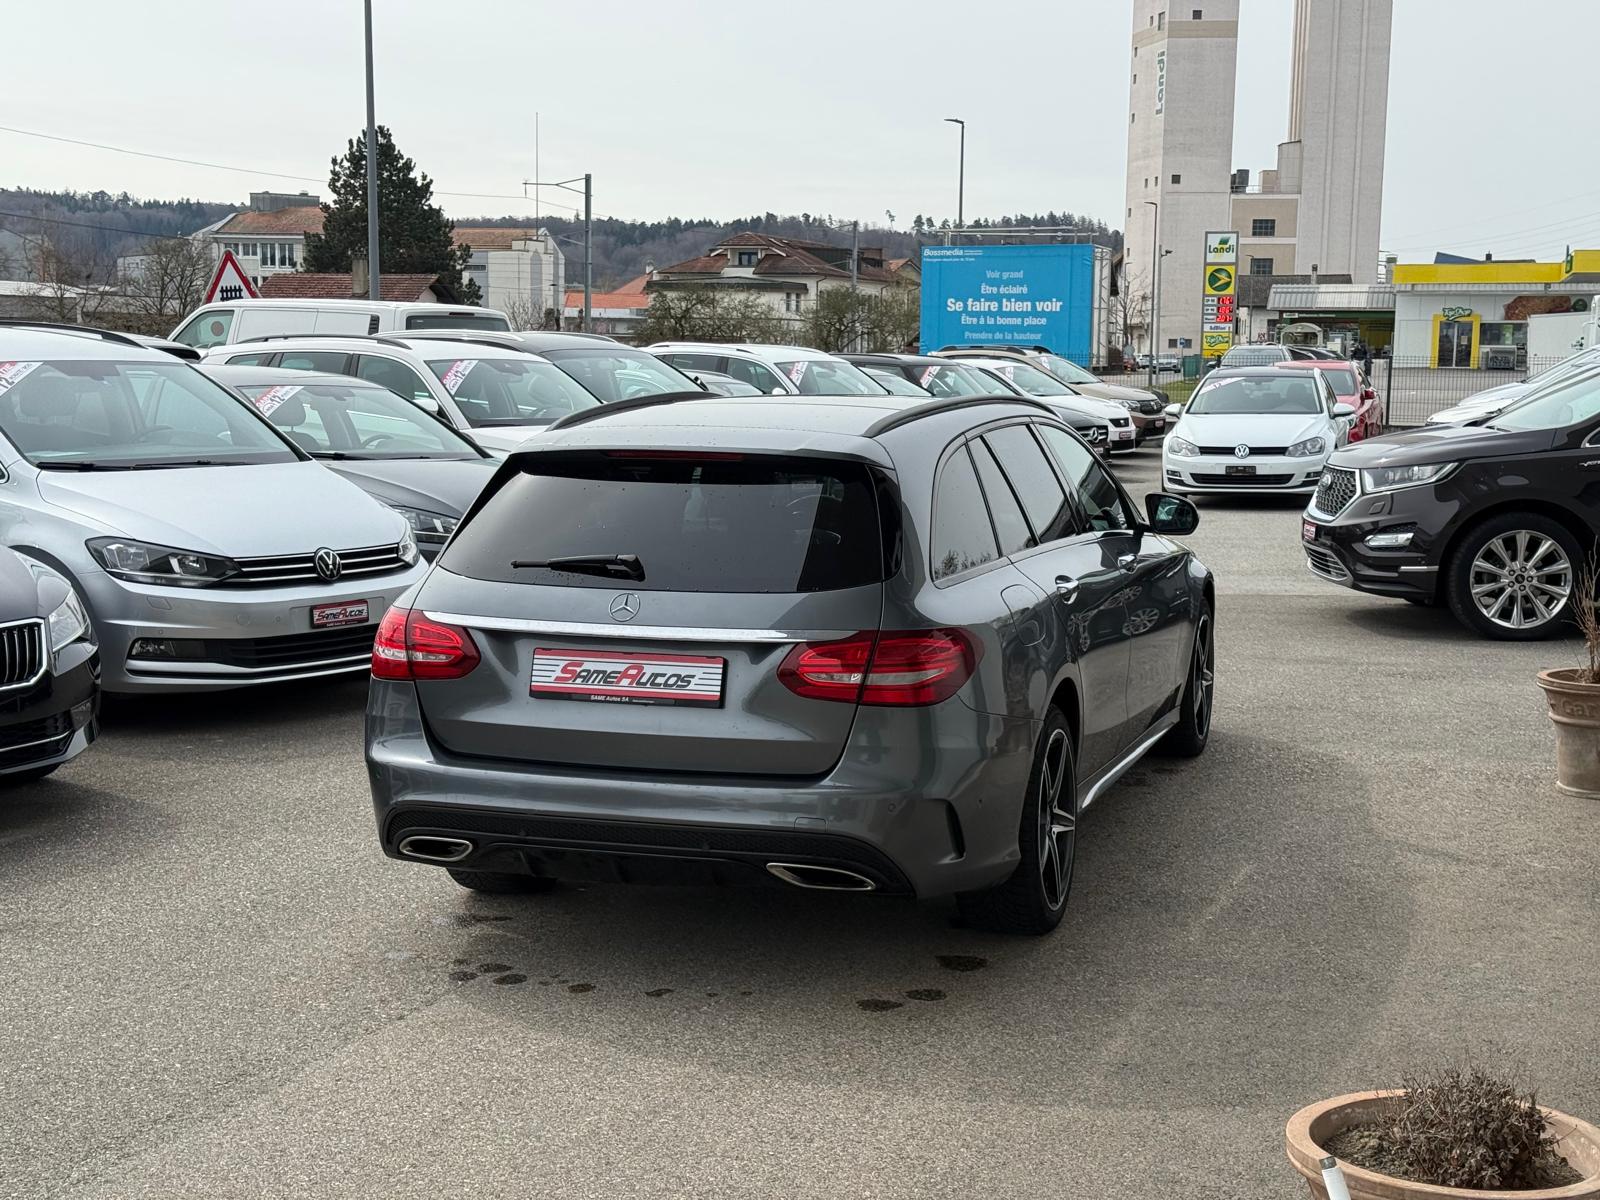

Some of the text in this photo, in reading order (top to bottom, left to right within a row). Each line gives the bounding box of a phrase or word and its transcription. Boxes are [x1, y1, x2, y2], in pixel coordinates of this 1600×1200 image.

[1155, 50, 1166, 115] Landi
[923, 248, 964, 256] Bossmedia
[1208, 244, 1235, 254] Landi
[986, 270, 1024, 280] Voir grand
[981, 282, 1028, 294] Être éclairé
[947, 298, 1063, 312] Se faire bien voir
[961, 314, 1047, 327] Être à la bonne place
[964, 331, 992, 339] Prendre
[1014, 332, 1042, 340] hauteur
